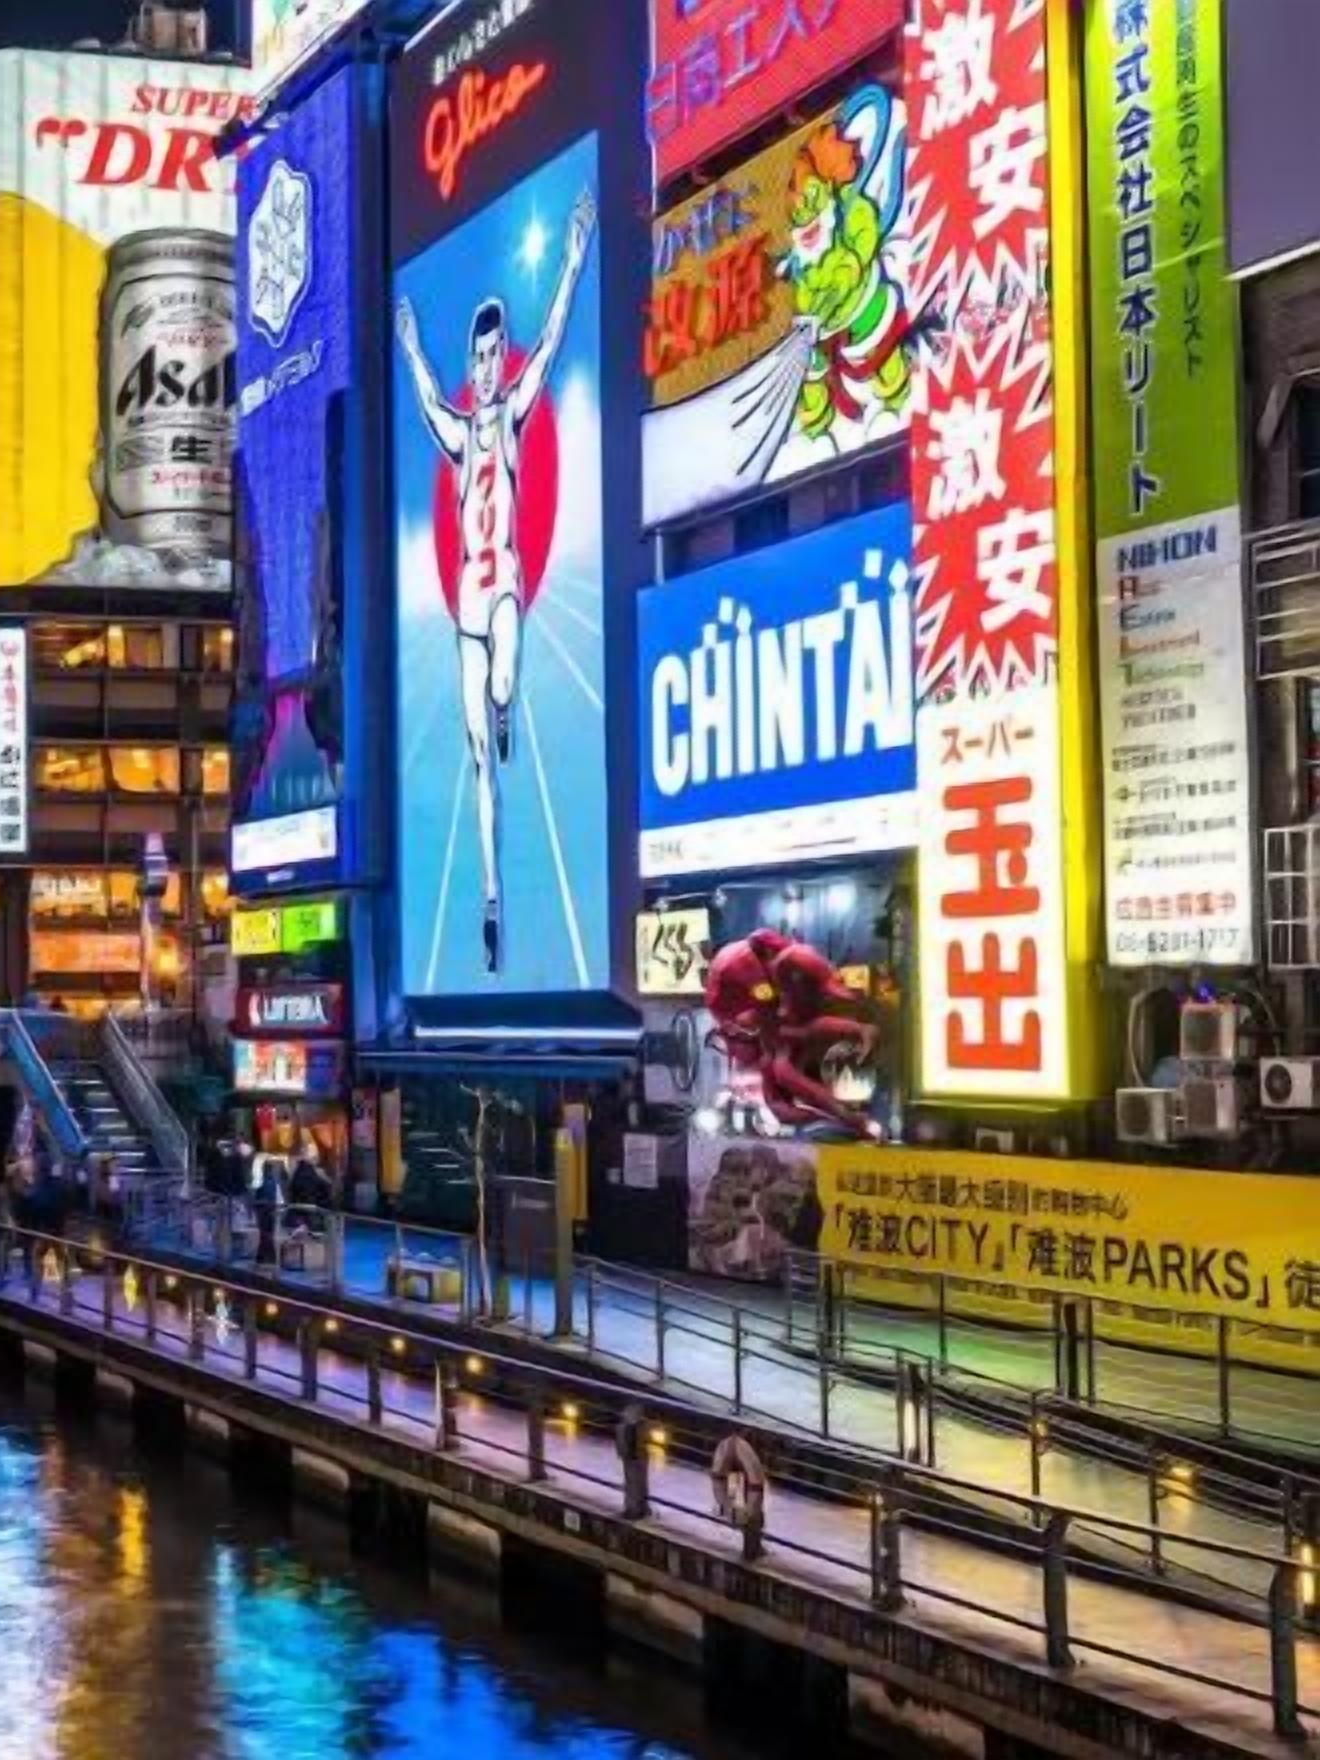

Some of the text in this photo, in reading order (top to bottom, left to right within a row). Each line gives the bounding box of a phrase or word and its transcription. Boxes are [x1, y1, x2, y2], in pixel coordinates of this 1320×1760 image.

[424, 62, 544, 202] Glico
[171, 434, 213, 465] 生
[923, 388, 1058, 632] 激安
[1117, 523, 1217, 572] NIHON
[651, 558, 913, 796] CHINTAI
[940, 719, 1035, 765] スーパー
[940, 776, 1042, 1072] 玉出
